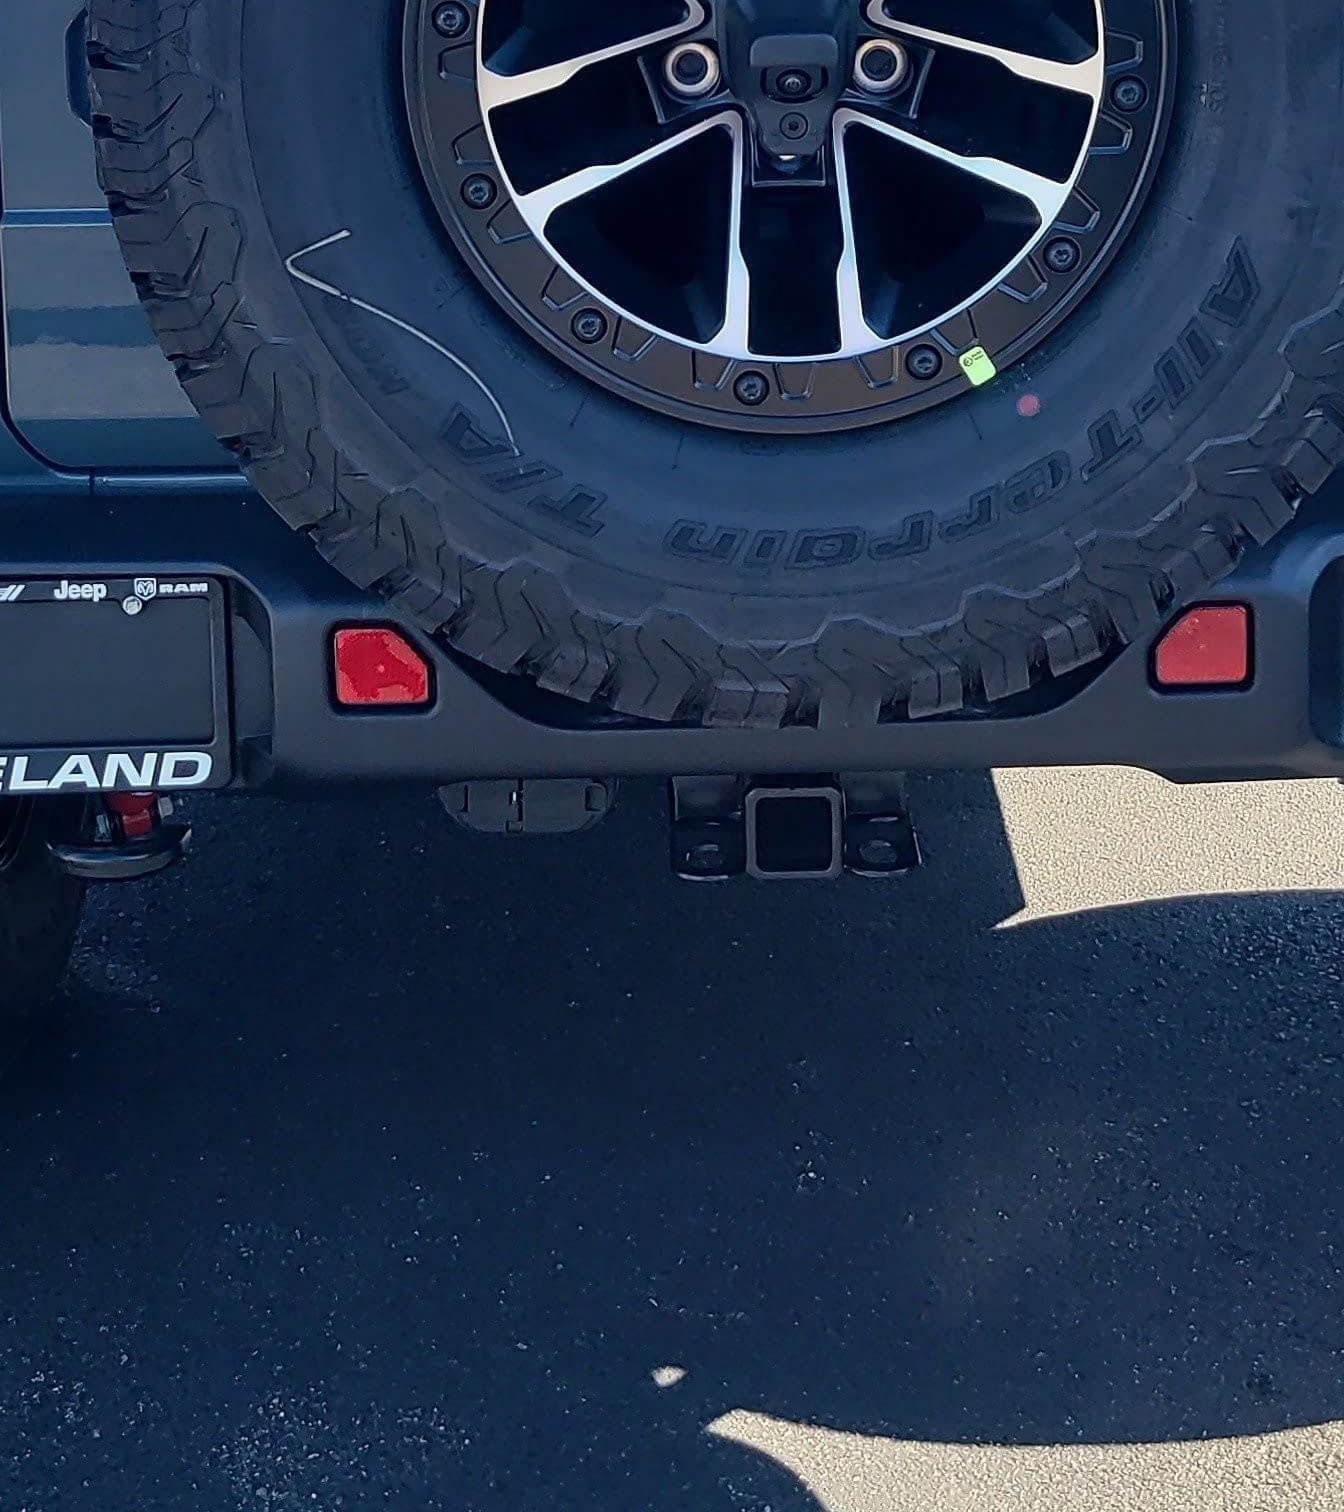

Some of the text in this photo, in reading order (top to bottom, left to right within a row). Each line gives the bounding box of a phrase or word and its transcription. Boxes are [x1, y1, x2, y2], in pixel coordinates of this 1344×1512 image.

[662, 235, 1262, 570] All-Terrain
[53, 580, 108, 602] Jeep
[159, 582, 209, 593] RAM
